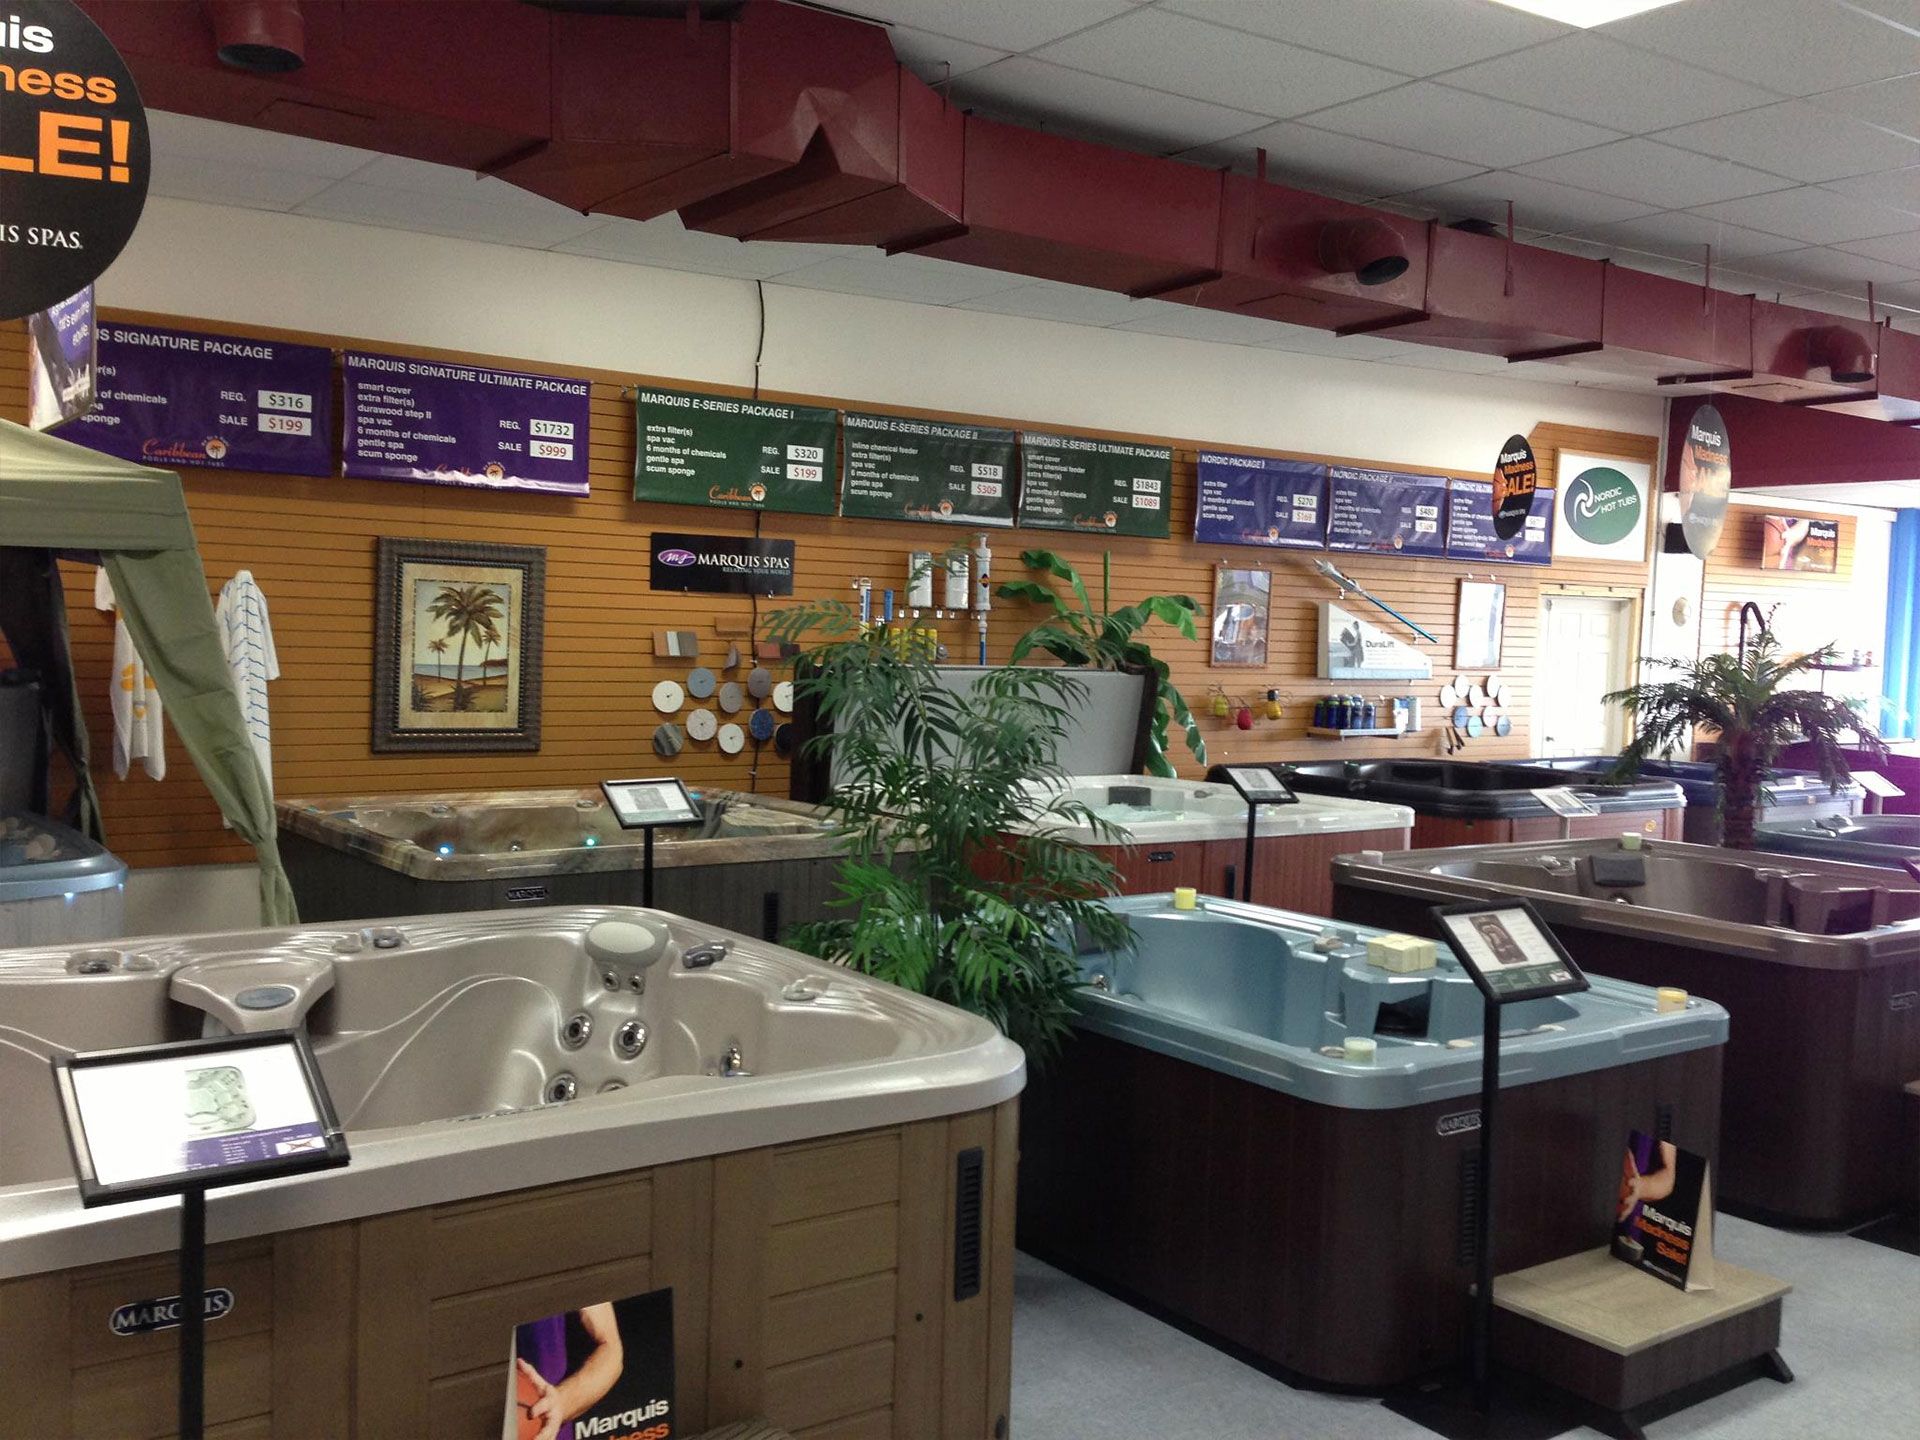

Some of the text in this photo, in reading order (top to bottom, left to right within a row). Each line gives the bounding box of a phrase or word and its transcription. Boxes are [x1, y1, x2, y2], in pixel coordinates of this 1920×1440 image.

[0, 15, 54, 53] is
[114, 330, 200, 352] SIGNATURE
[203, 341, 273, 360] PACKAGE
[96, 366, 116, 376] r(s)
[348, 355, 587, 396] MARQUIS SIGNATURE ULTIMATE PACKAGE
[358, 381, 411, 395] smart cover
[101, 389, 112, 399] of
[114, 391, 167, 404] chemicals
[220, 390, 304, 409] REG. $316
[358, 393, 415, 407] extra filter(s)
[358, 404, 403, 416] durawood
[405, 408, 424, 419] step
[641, 393, 690, 408] MARQUIS
[692, 399, 739, 414] E-SERIES
[742, 405, 788, 419] PACKAGE
[219, 415, 303, 432] SALE $199
[358, 416, 392, 426] spa vac
[500, 420, 570, 436] REG. $1732
[847, 417, 888, 430] MARQUIS
[890, 422, 930, 435] E-SERIES
[931, 427, 972, 439] PACKAGE
[358, 426, 456, 444] 6 months of chemicals
[667, 426, 693, 436] filter(s)
[1692, 425, 1721, 448] Marquis
[358, 438, 404, 450] gentle spa
[646, 435, 661, 443] spa
[498, 442, 567, 457] SALE $999
[653, 445, 681, 455] months
[691, 449, 727, 459] chemicals
[762, 446, 818, 459] REG. $320
[1024, 436, 1170, 460] MARQUIS E-SERIES ULTIMATE PACKAGE
[358, 450, 418, 463] scum sponge
[646, 455, 669, 464] gentle
[1202, 455, 1228, 466] NORDIC
[1229, 458, 1261, 468] PACKAGE
[1500, 449, 1527, 464] Marquis
[668, 468, 695, 476] sponge
[760, 466, 817, 479] SALE $199
[856, 470, 880, 479] months
[889, 473, 919, 482] chemicals
[948, 483, 996, 494] SALE $309
[1594, 486, 1622, 503] NORDIC
[1601, 495, 1637, 514] HOT TUBS
[698, 553, 760, 569] MARQUIS
[763, 557, 789, 569] SPAS
[575, 1399, 669, 1440] Marquis
